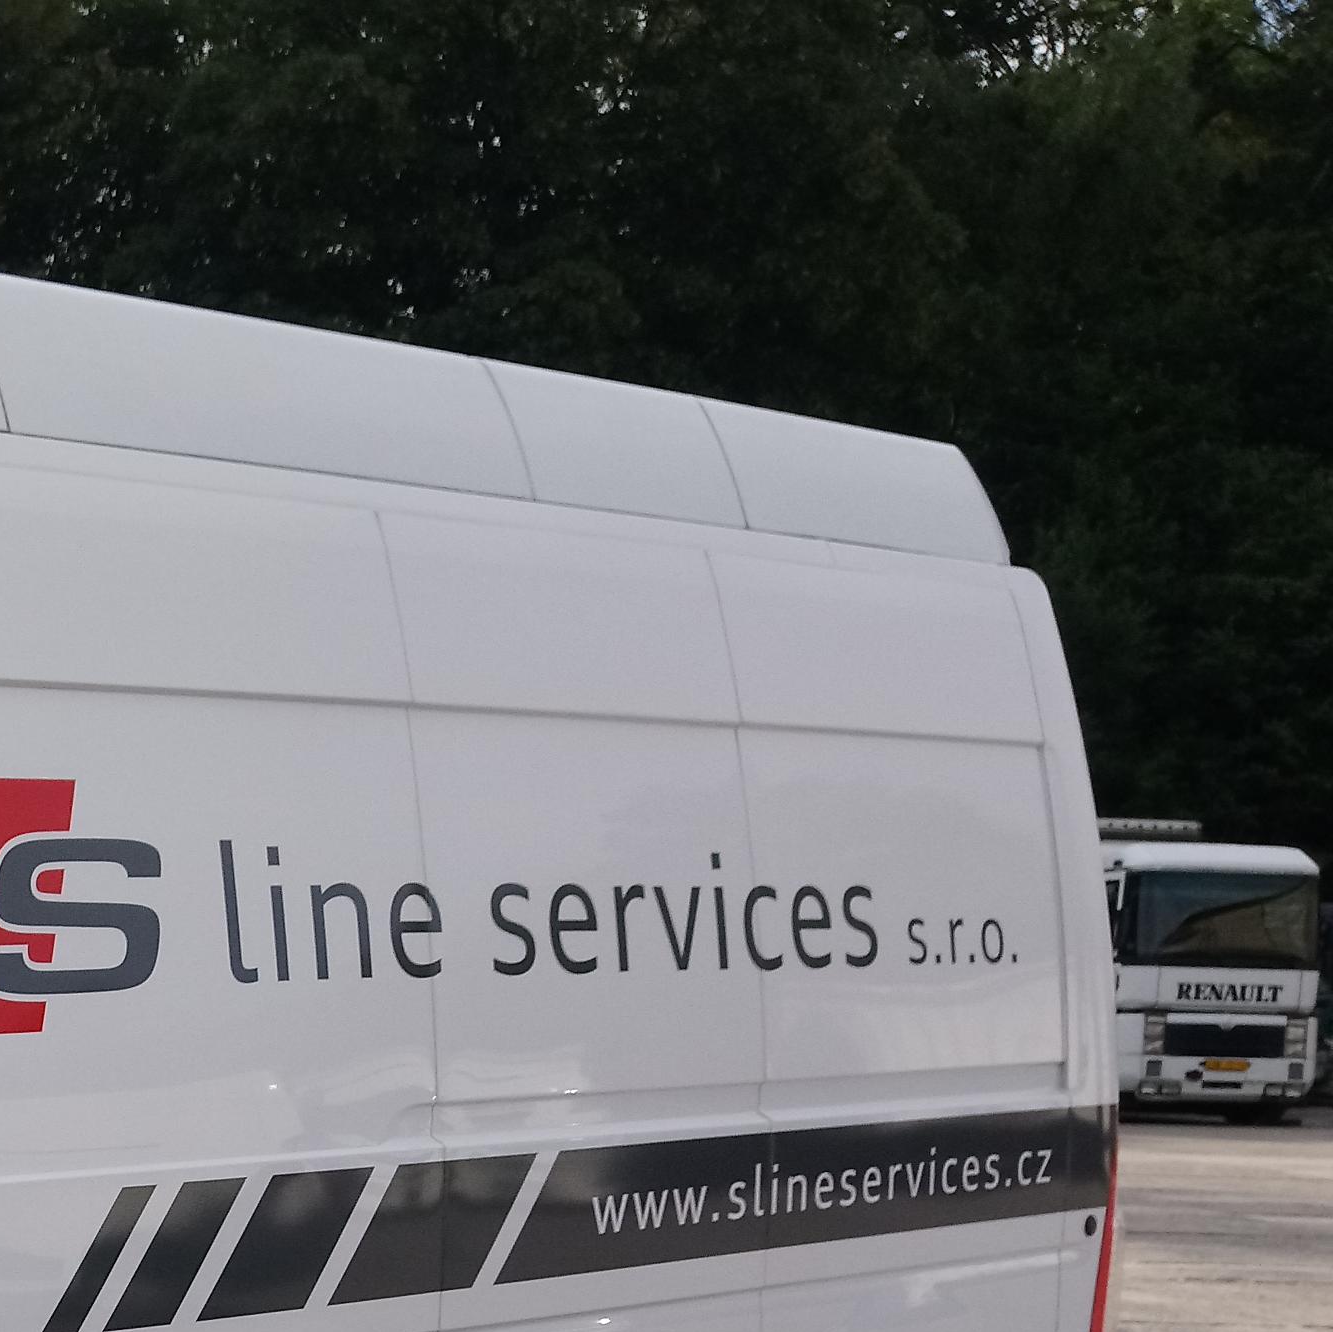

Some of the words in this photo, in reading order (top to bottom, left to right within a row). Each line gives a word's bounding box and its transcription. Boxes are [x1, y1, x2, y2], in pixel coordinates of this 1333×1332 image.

[219, 840, 444, 985] line
[491, 853, 879, 976] services
[907, 915, 1020, 967] s.r.o.
[1176, 982, 1283, 1002] RENAULT
[591, 1144, 1054, 1236] www.slineservices.cz
